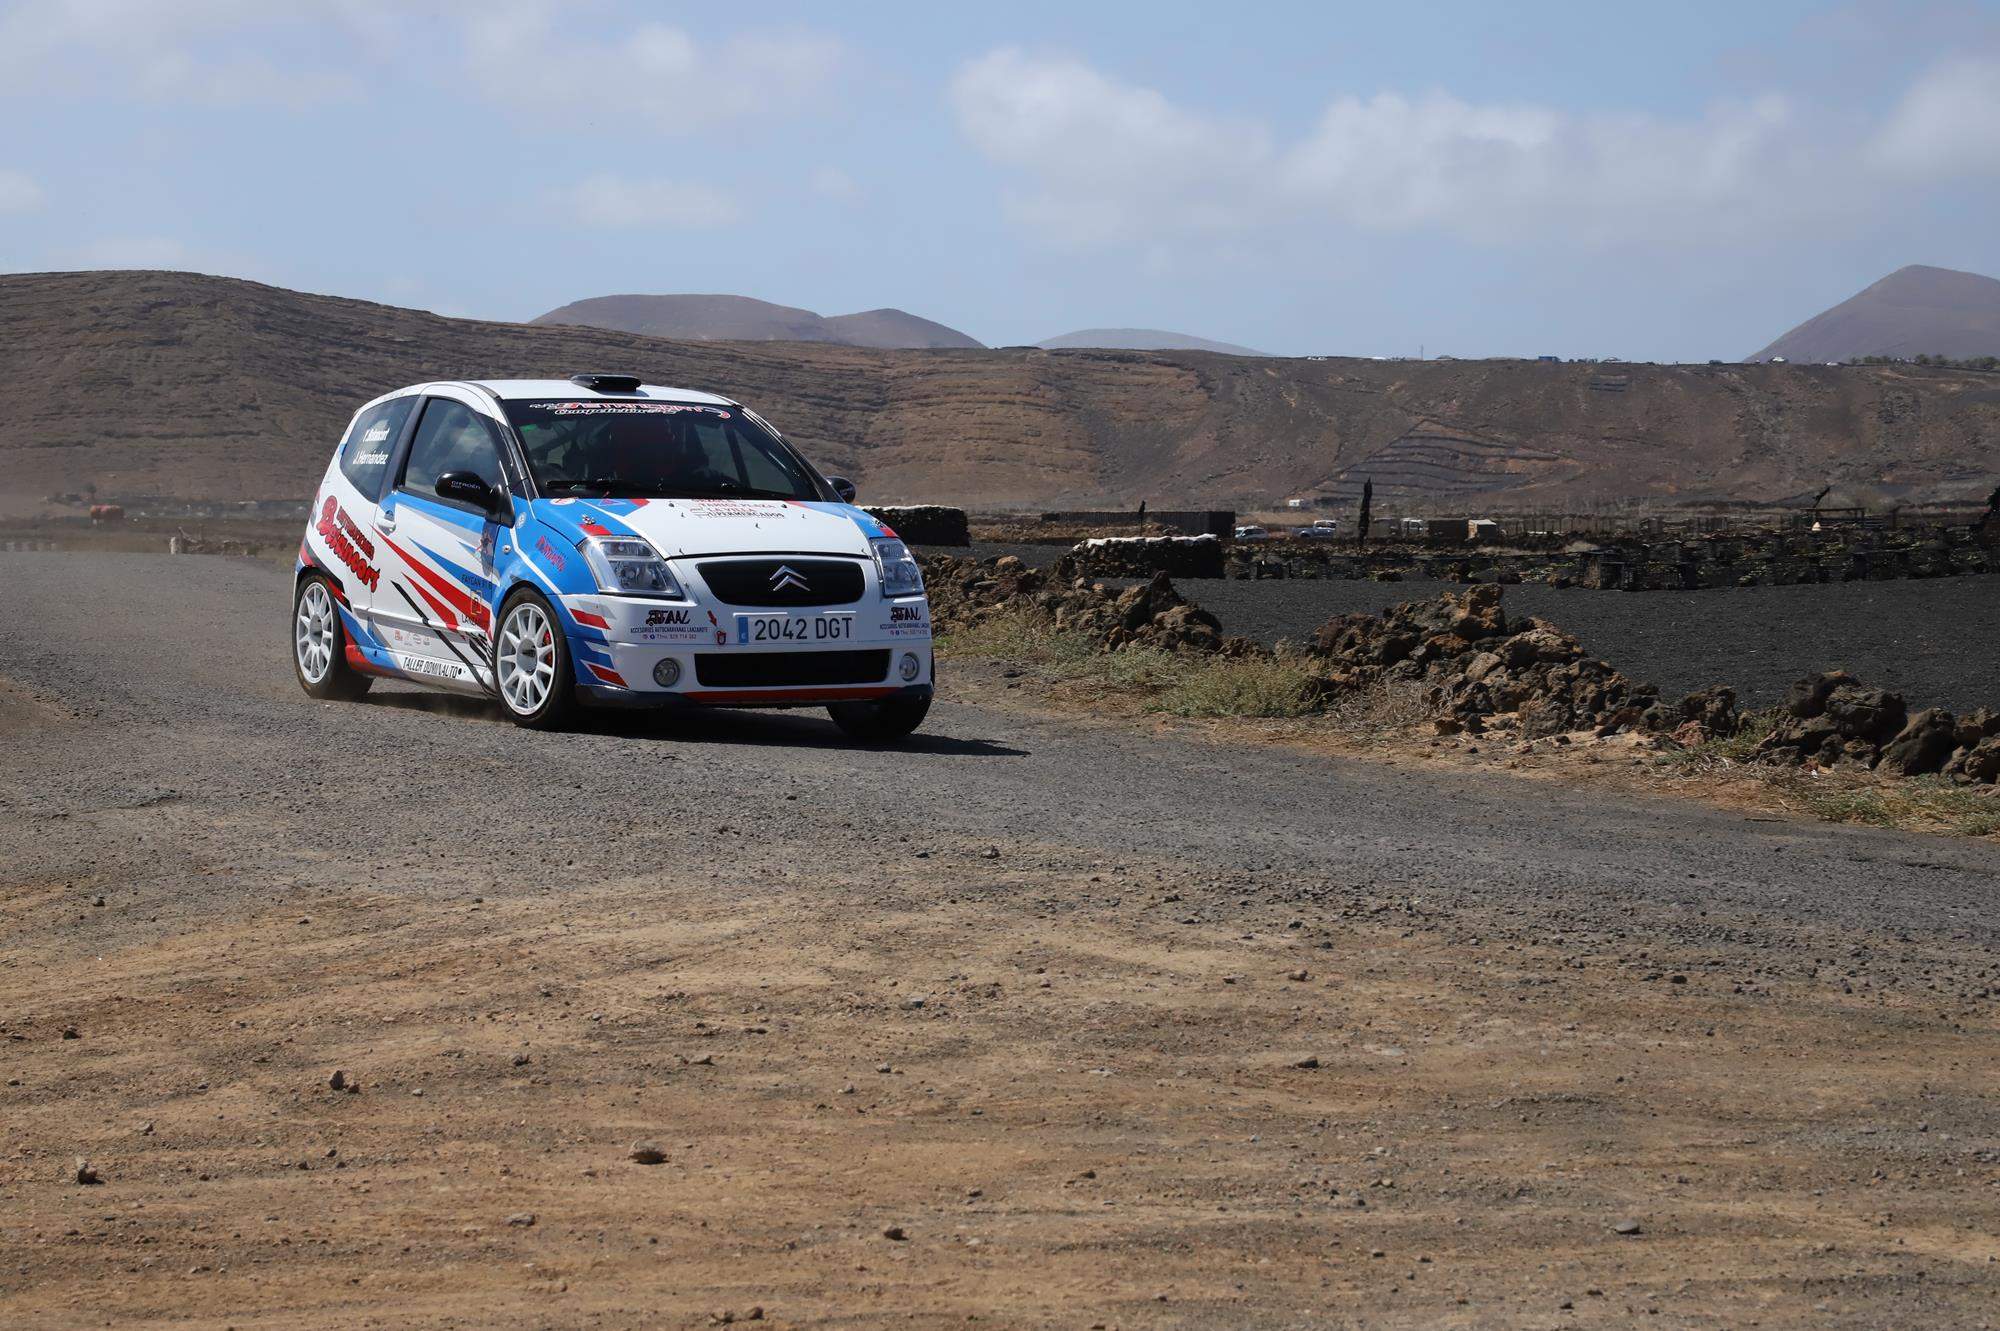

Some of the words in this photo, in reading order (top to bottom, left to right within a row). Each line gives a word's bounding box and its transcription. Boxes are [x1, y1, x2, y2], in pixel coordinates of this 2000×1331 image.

[754, 619, 808, 640] 2042
[816, 618, 853, 639] DGT
[403, 656, 425, 673] TALLER
